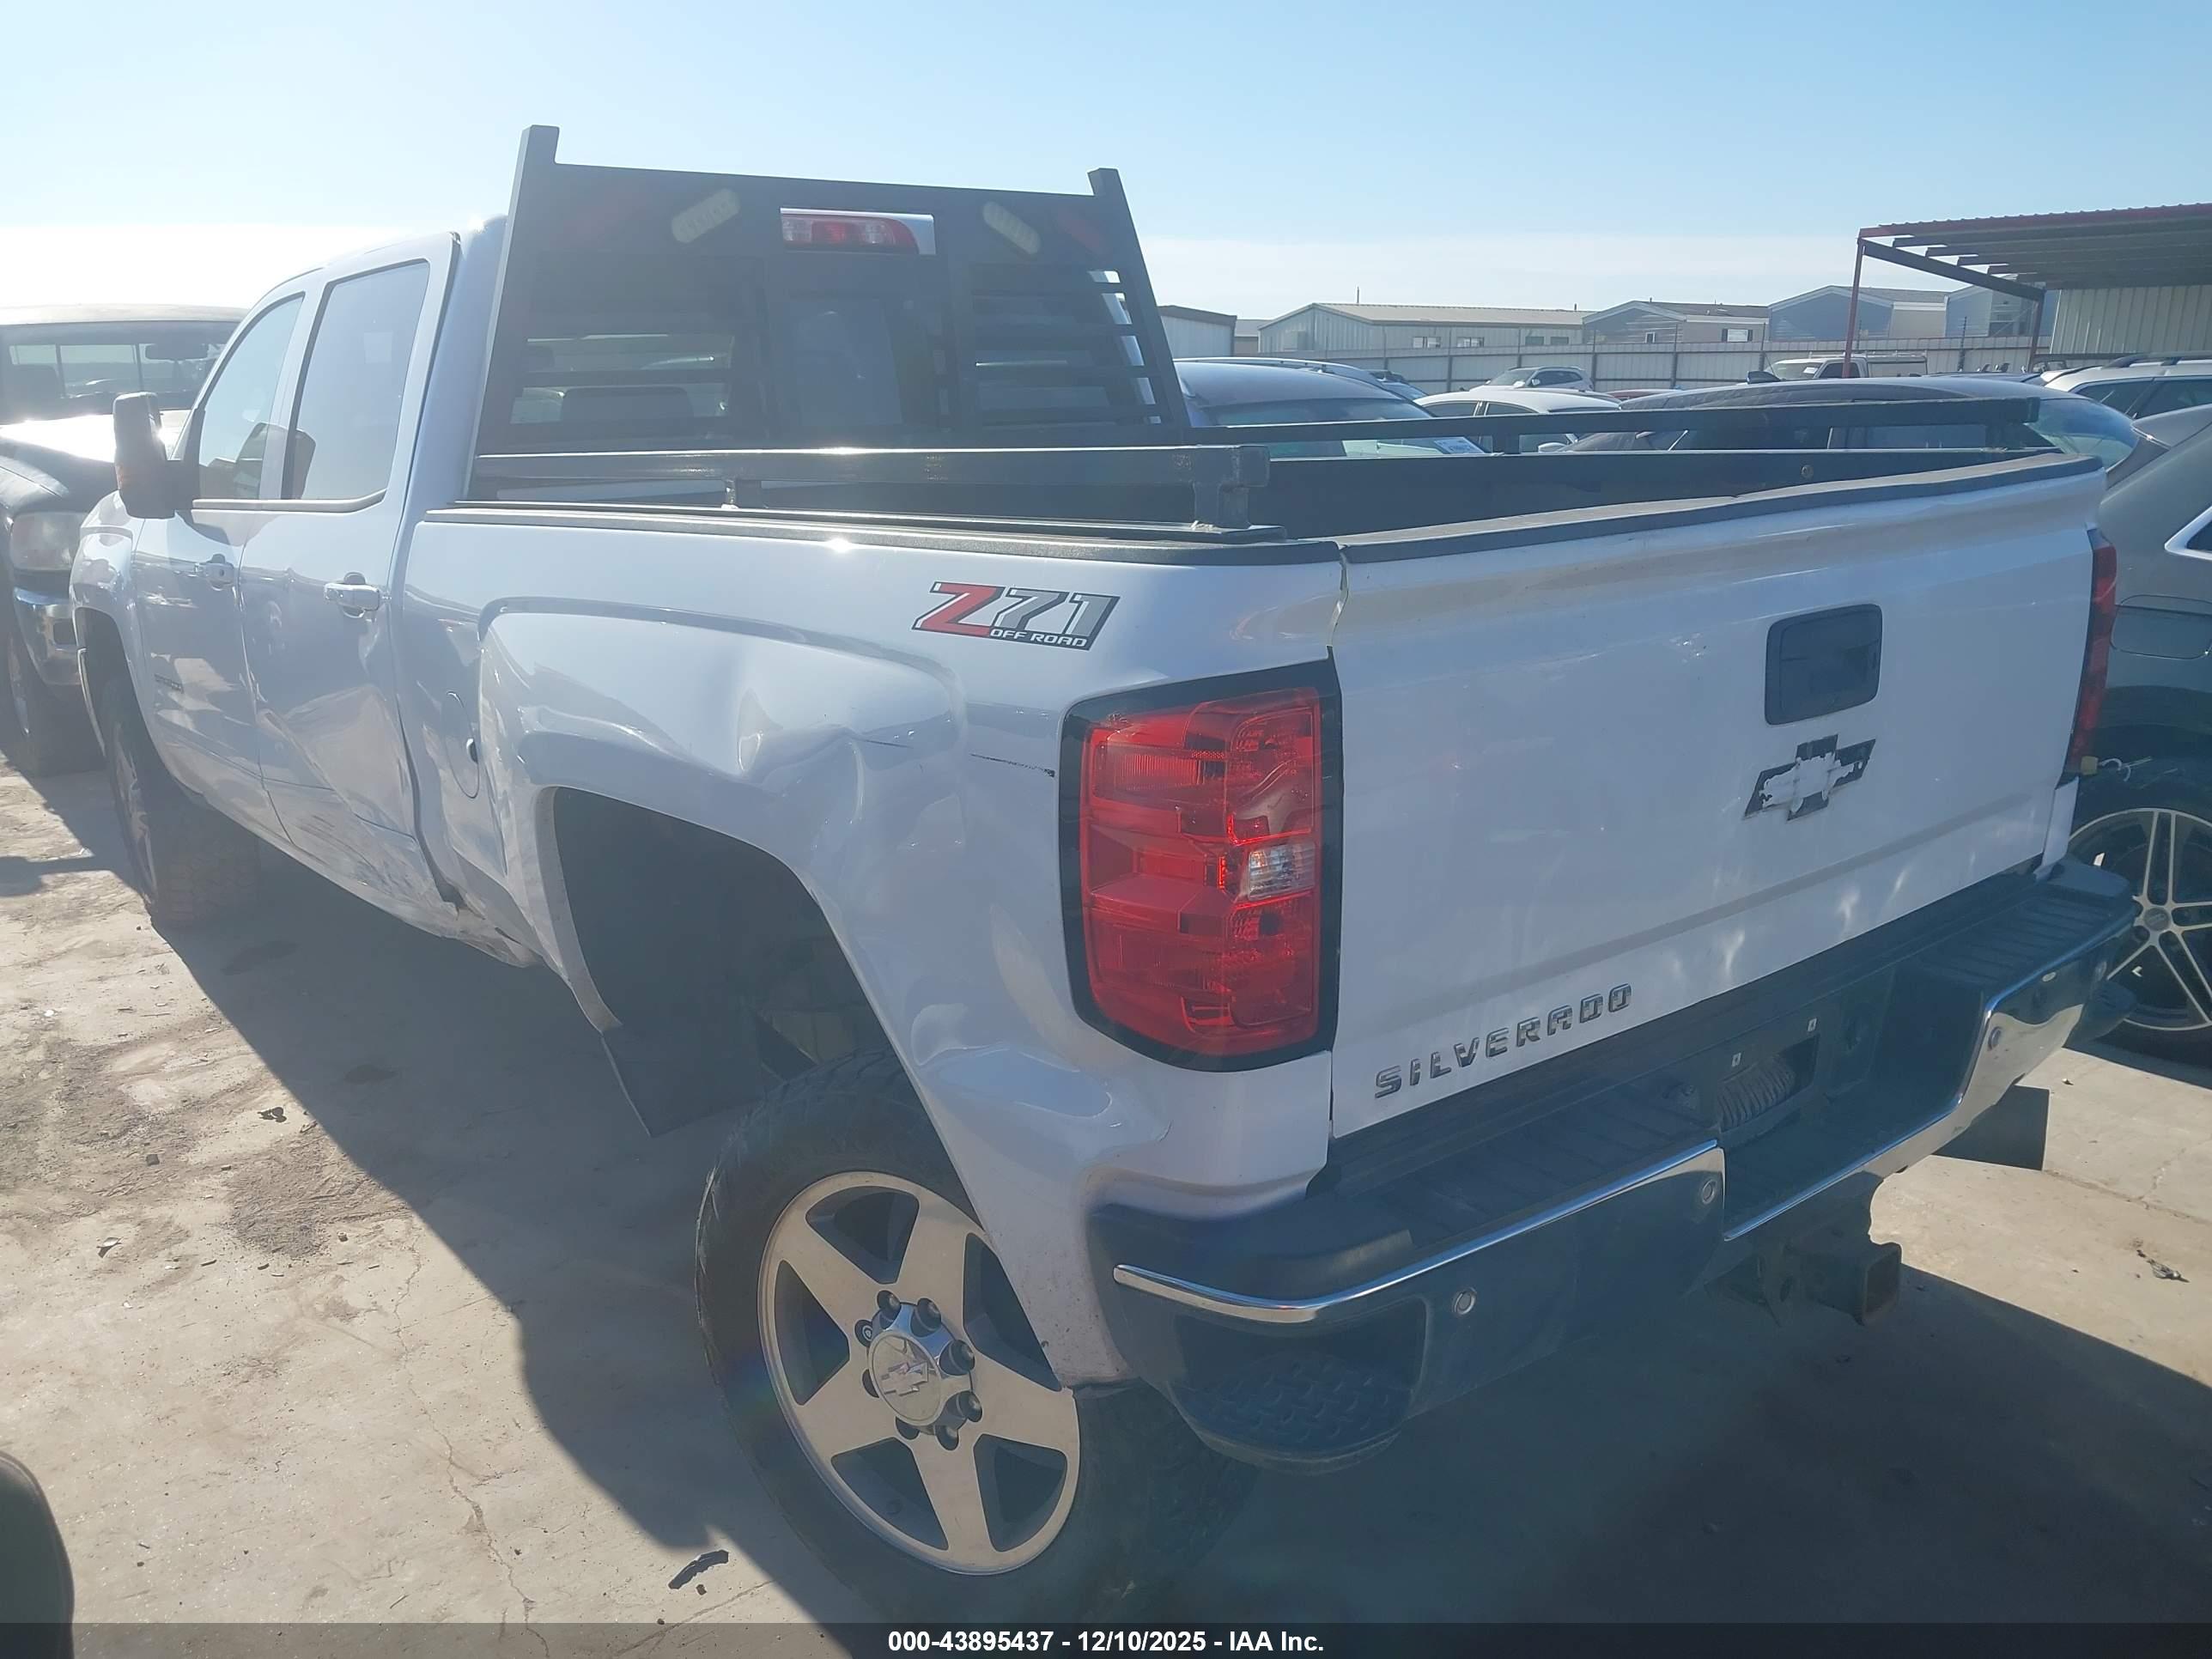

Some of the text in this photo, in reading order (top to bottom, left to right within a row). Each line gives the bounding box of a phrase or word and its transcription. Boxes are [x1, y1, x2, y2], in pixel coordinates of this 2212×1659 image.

[911, 580, 1121, 641] Z71
[989, 628, 1088, 647] OFF ROAD
[1374, 982, 1632, 1099] SILVERADO
